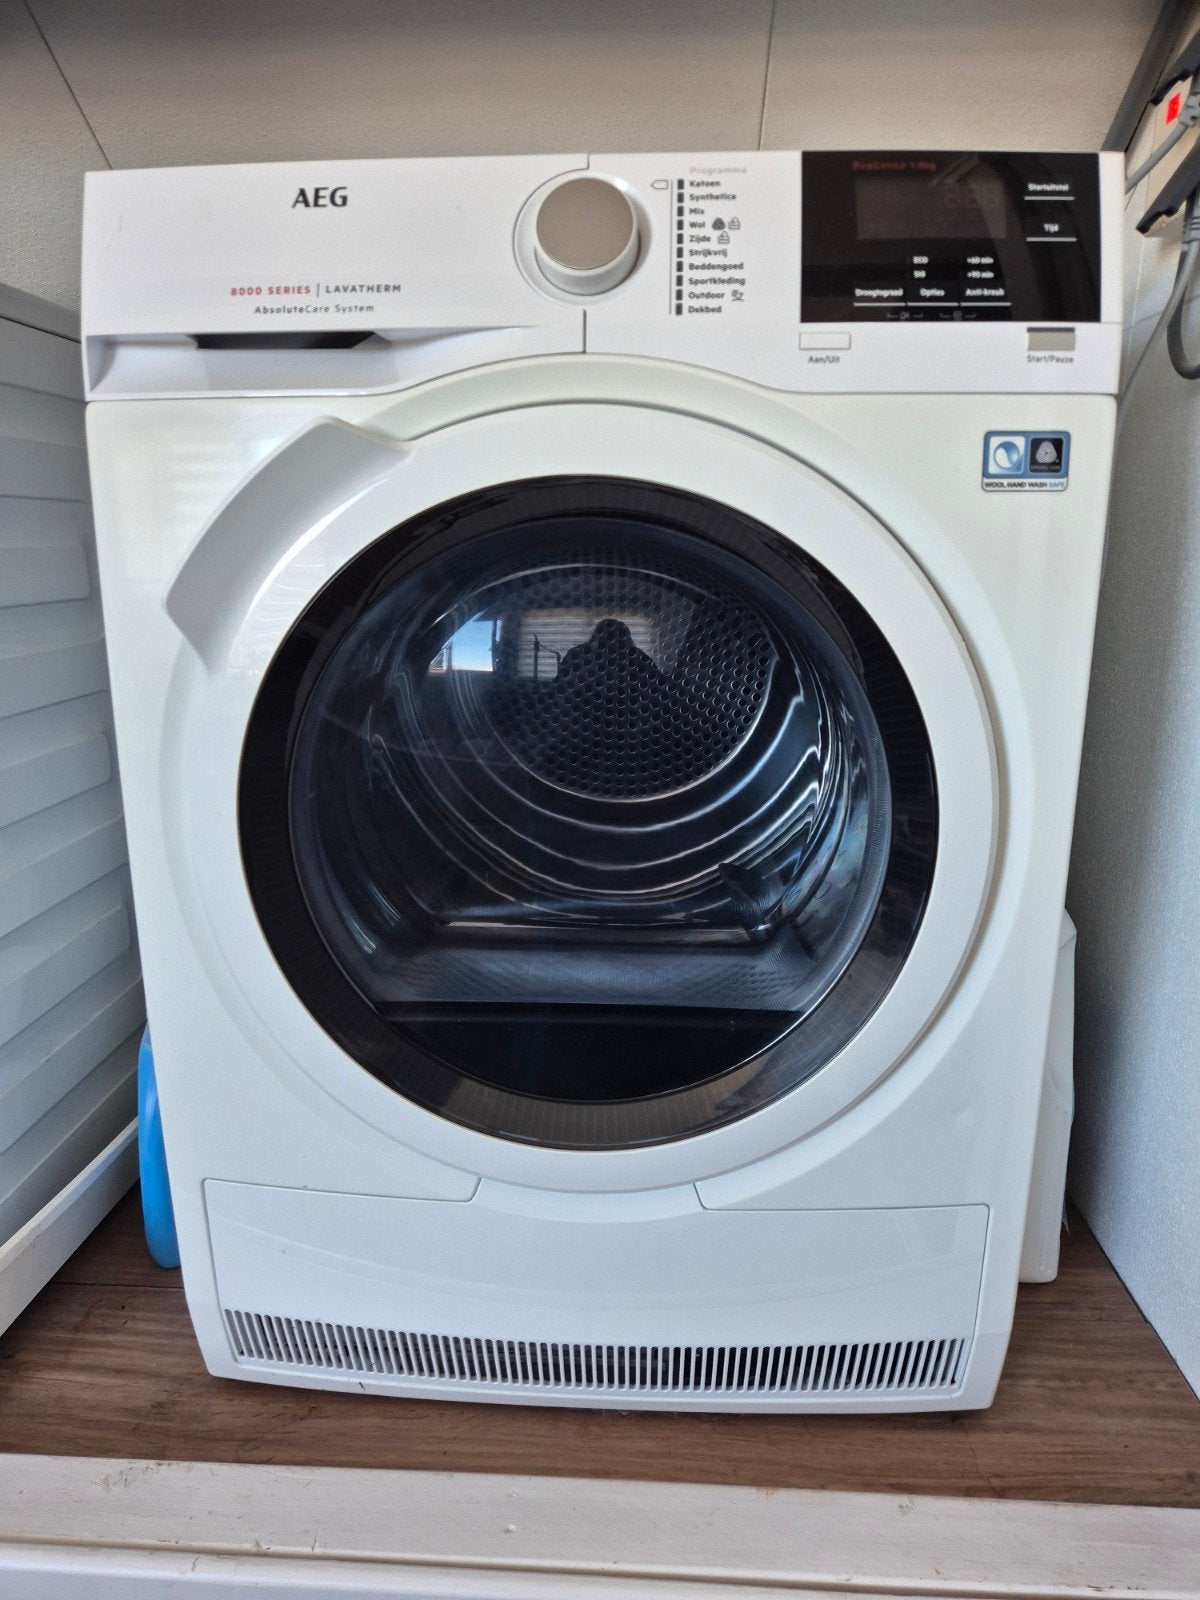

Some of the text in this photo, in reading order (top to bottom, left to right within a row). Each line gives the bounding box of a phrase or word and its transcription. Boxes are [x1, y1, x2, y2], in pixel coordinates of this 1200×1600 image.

[291, 186, 348, 208] AEG
[689, 193, 736, 201] Synthetica
[689, 234, 712, 243] Zijde
[689, 248, 728, 257] Strijkvrij
[688, 262, 744, 271] Beddengoed
[688, 277, 746, 286] Sportkleding
[231, 284, 401, 296] 8000 SERIES LAVATHERM
[688, 291, 726, 299] Outdoor
[254, 304, 375, 314] AbsoluteCare System
[688, 305, 722, 313] Dekbed
[808, 355, 840, 364] Aan/Uit
[1027, 354, 1074, 364] Start/Pauze
